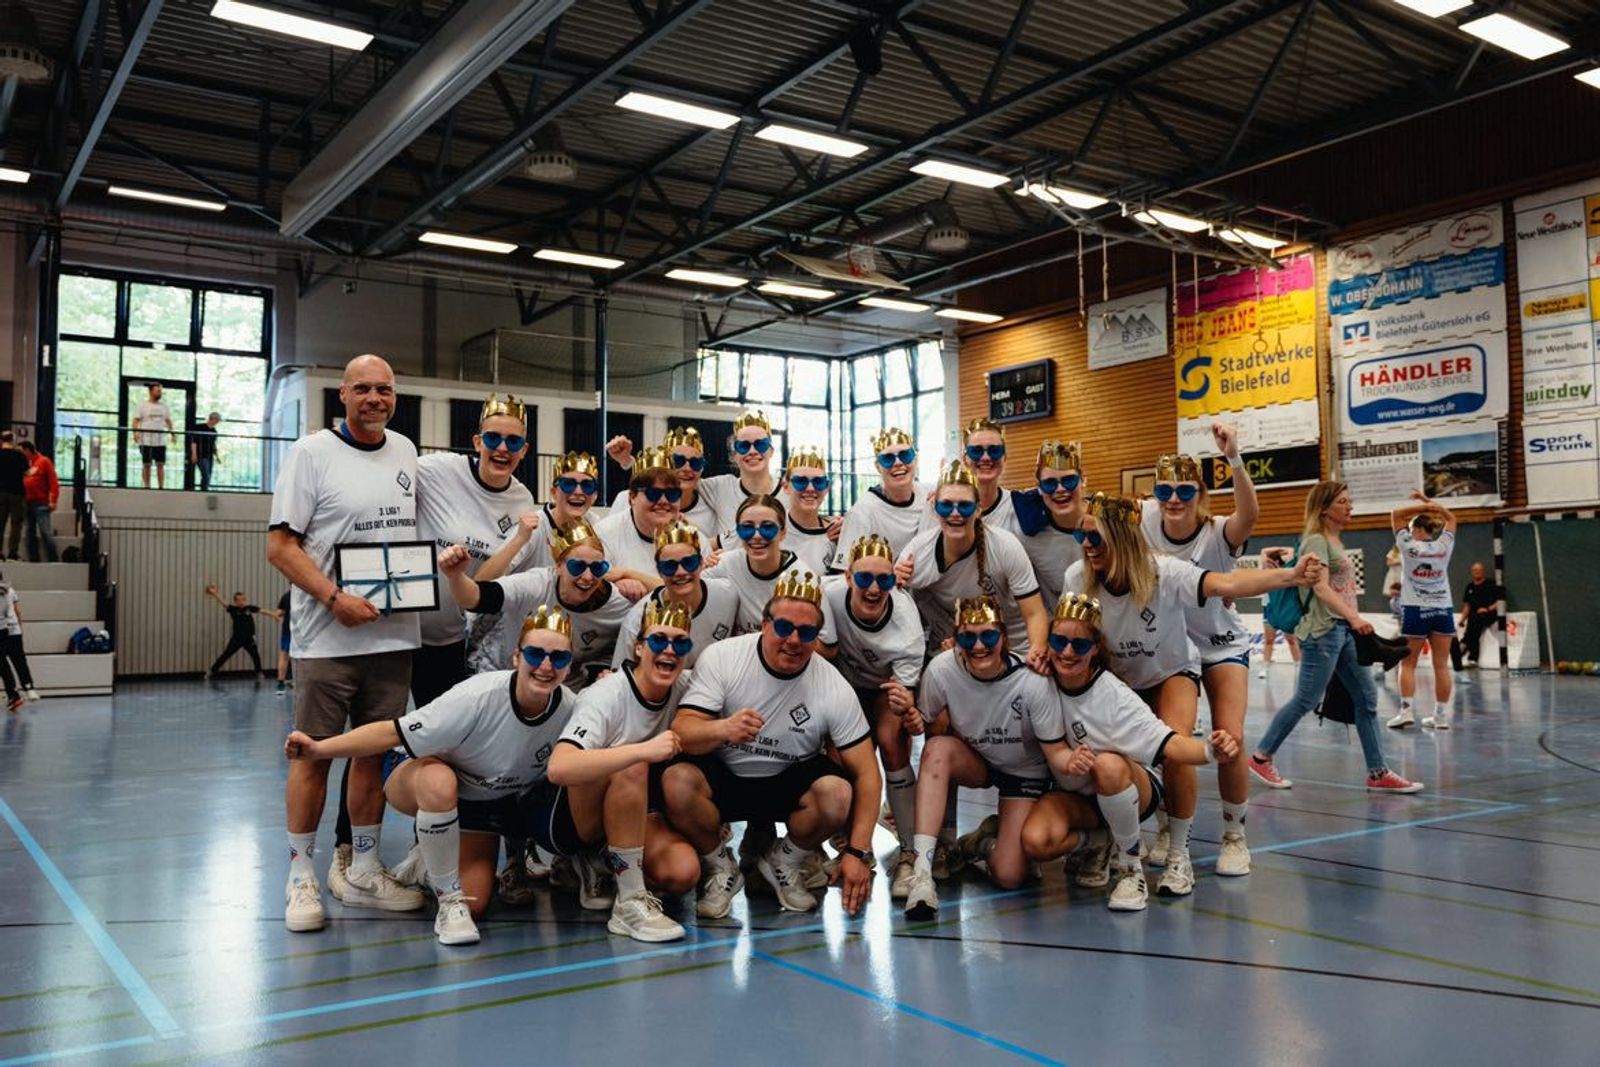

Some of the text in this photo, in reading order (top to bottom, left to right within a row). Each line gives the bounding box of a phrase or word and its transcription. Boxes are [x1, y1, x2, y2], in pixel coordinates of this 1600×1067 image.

[1211, 306, 1256, 338] JEANS
[1375, 310, 1426, 327] Volksbank
[1475, 310, 1491, 322] eG
[1545, 341, 1589, 354] Werbung
[1219, 344, 1314, 374] Stadtwerke
[1359, 356, 1473, 387] HÄNDLER
[1220, 366, 1291, 395] Bielefeld
[1025, 383, 1045, 395] GAST
[1524, 382, 1593, 403] wiedey
[1024, 398, 1037, 413] 24
[1215, 463, 1226, 481] 3
[354, 520, 373, 531] ALLES
[408, 721, 423, 732] 8
[573, 726, 587, 738] 14
